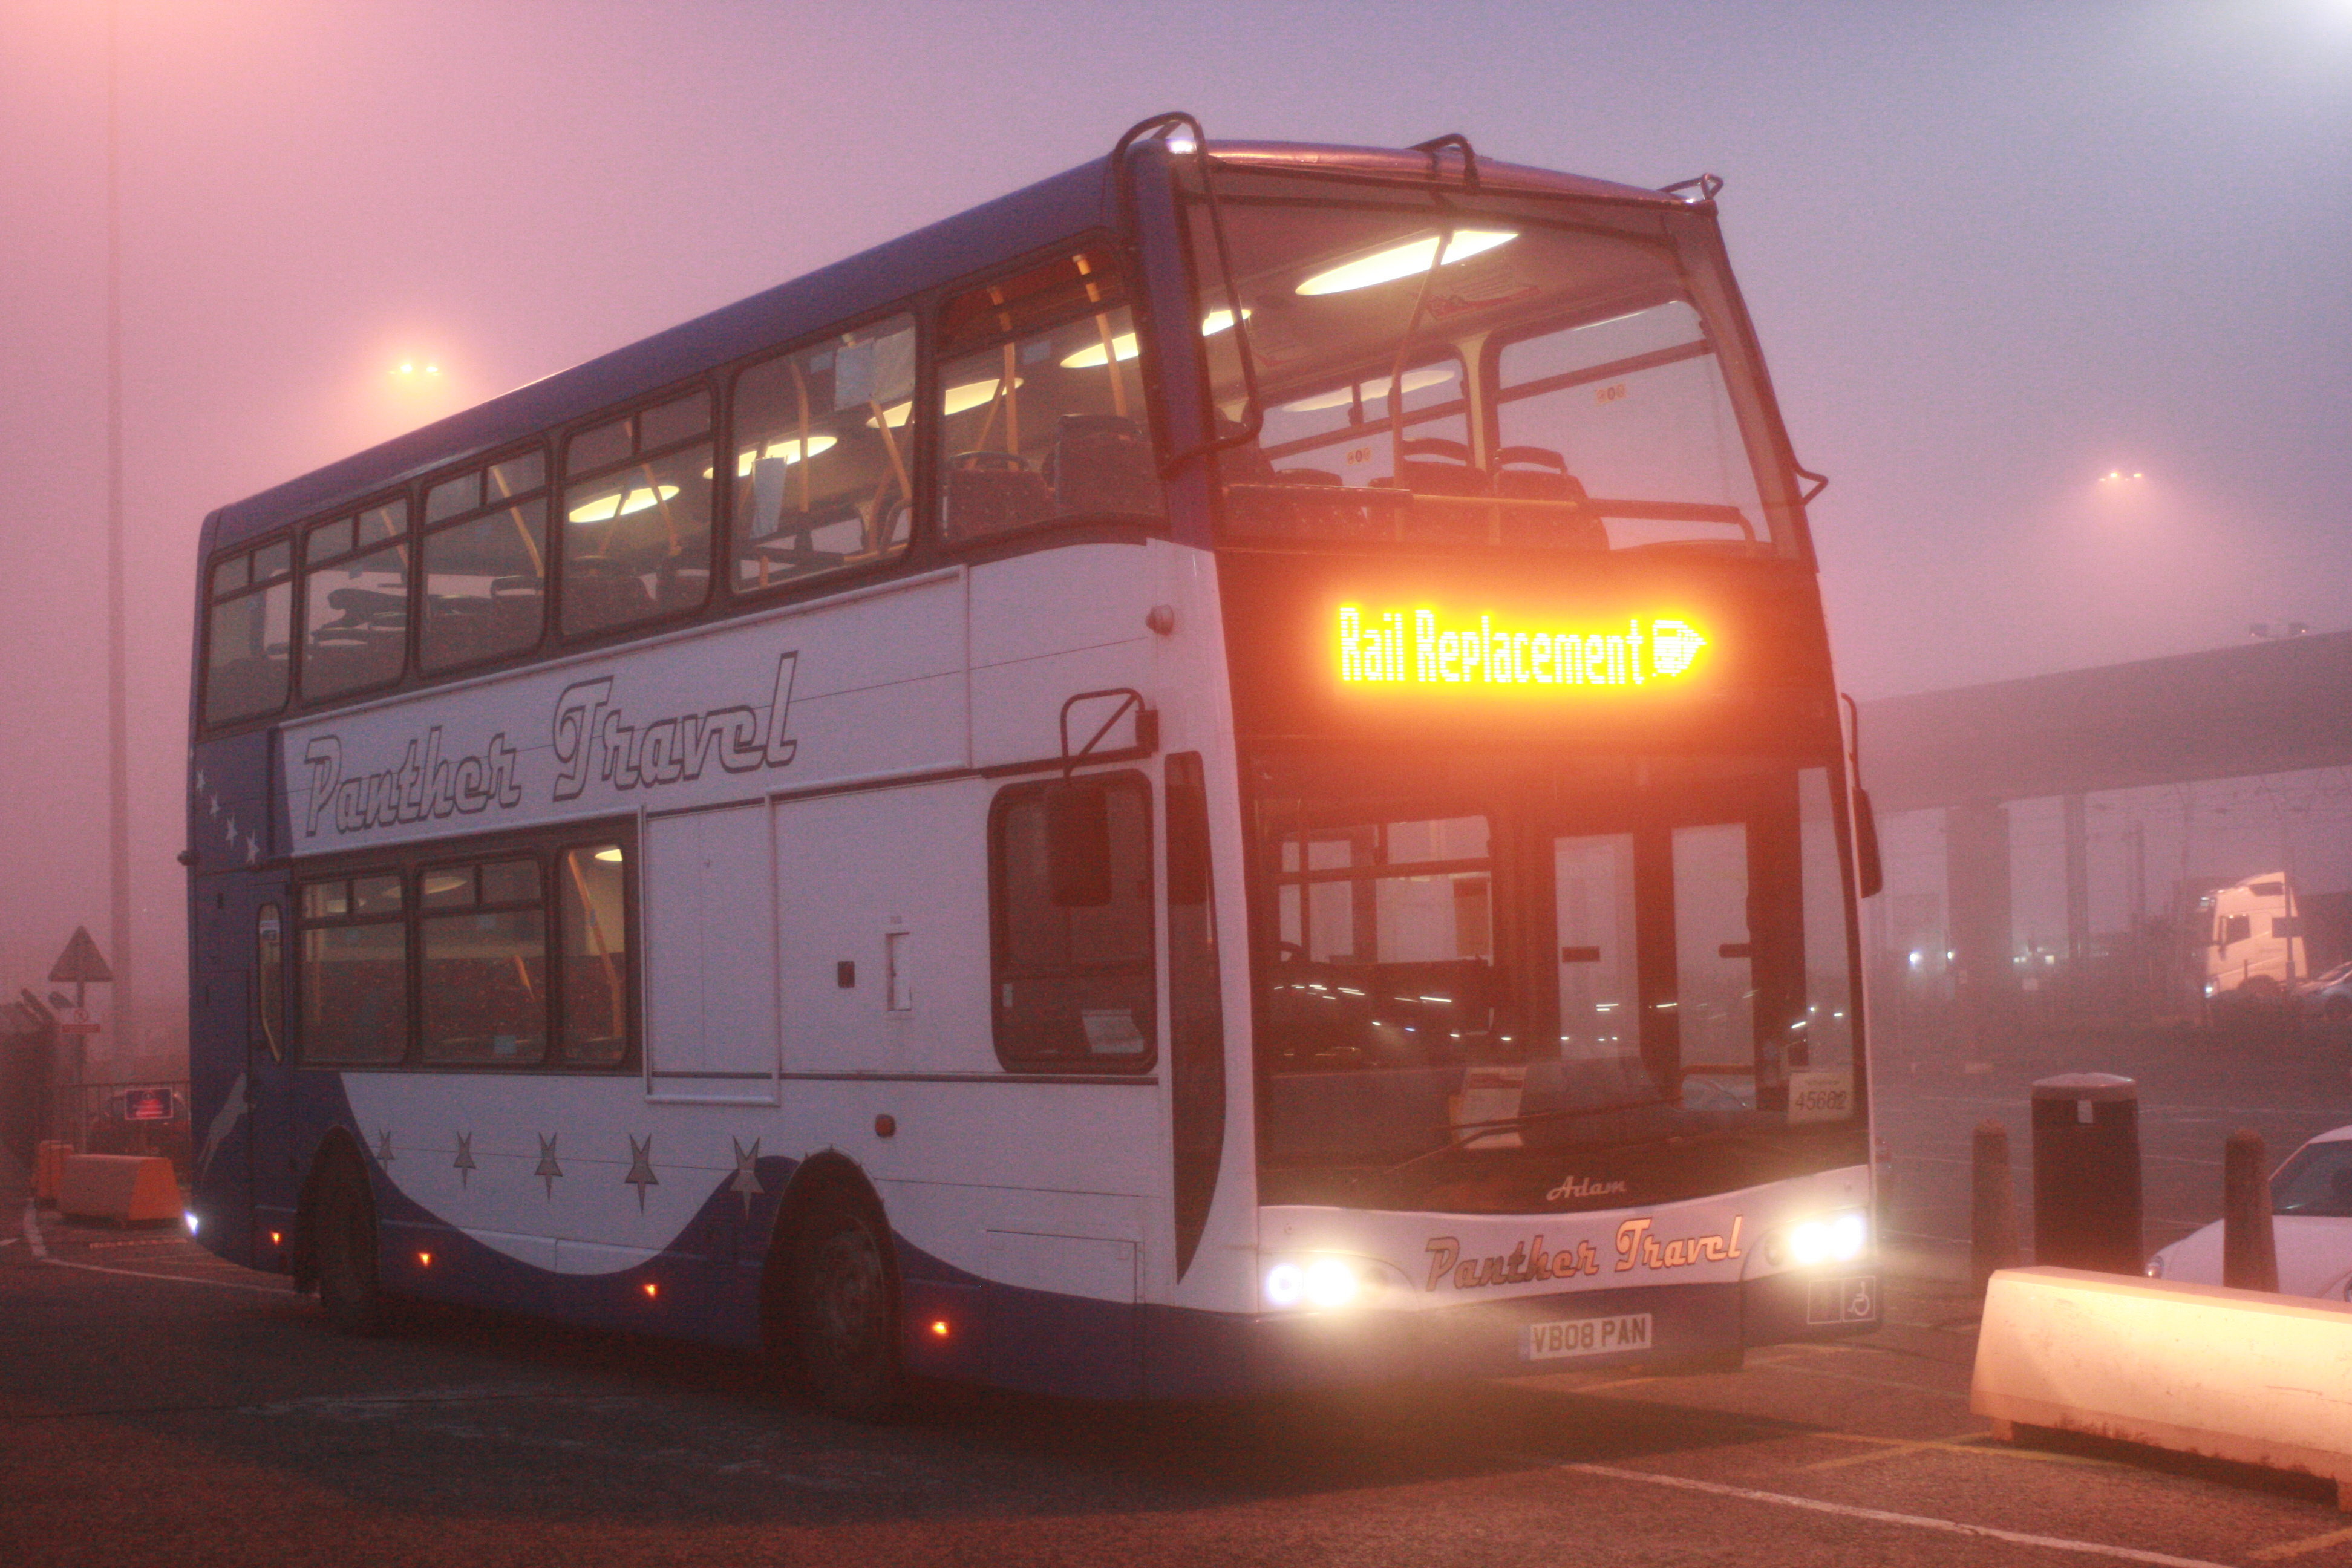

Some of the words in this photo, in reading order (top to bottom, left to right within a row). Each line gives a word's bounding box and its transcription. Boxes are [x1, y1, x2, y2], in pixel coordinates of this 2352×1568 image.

[1339, 607, 1405, 681] Rail
[1414, 609, 1644, 684] Replacement
[304, 726, 521, 838] Panther
[552, 650, 799, 802] Travel
[1546, 1175, 1627, 1201] Adam
[1425, 1235, 1599, 1293] Panther
[1615, 1215, 1743, 1272] Travel
[1602, 1317, 1646, 1347] PAN
